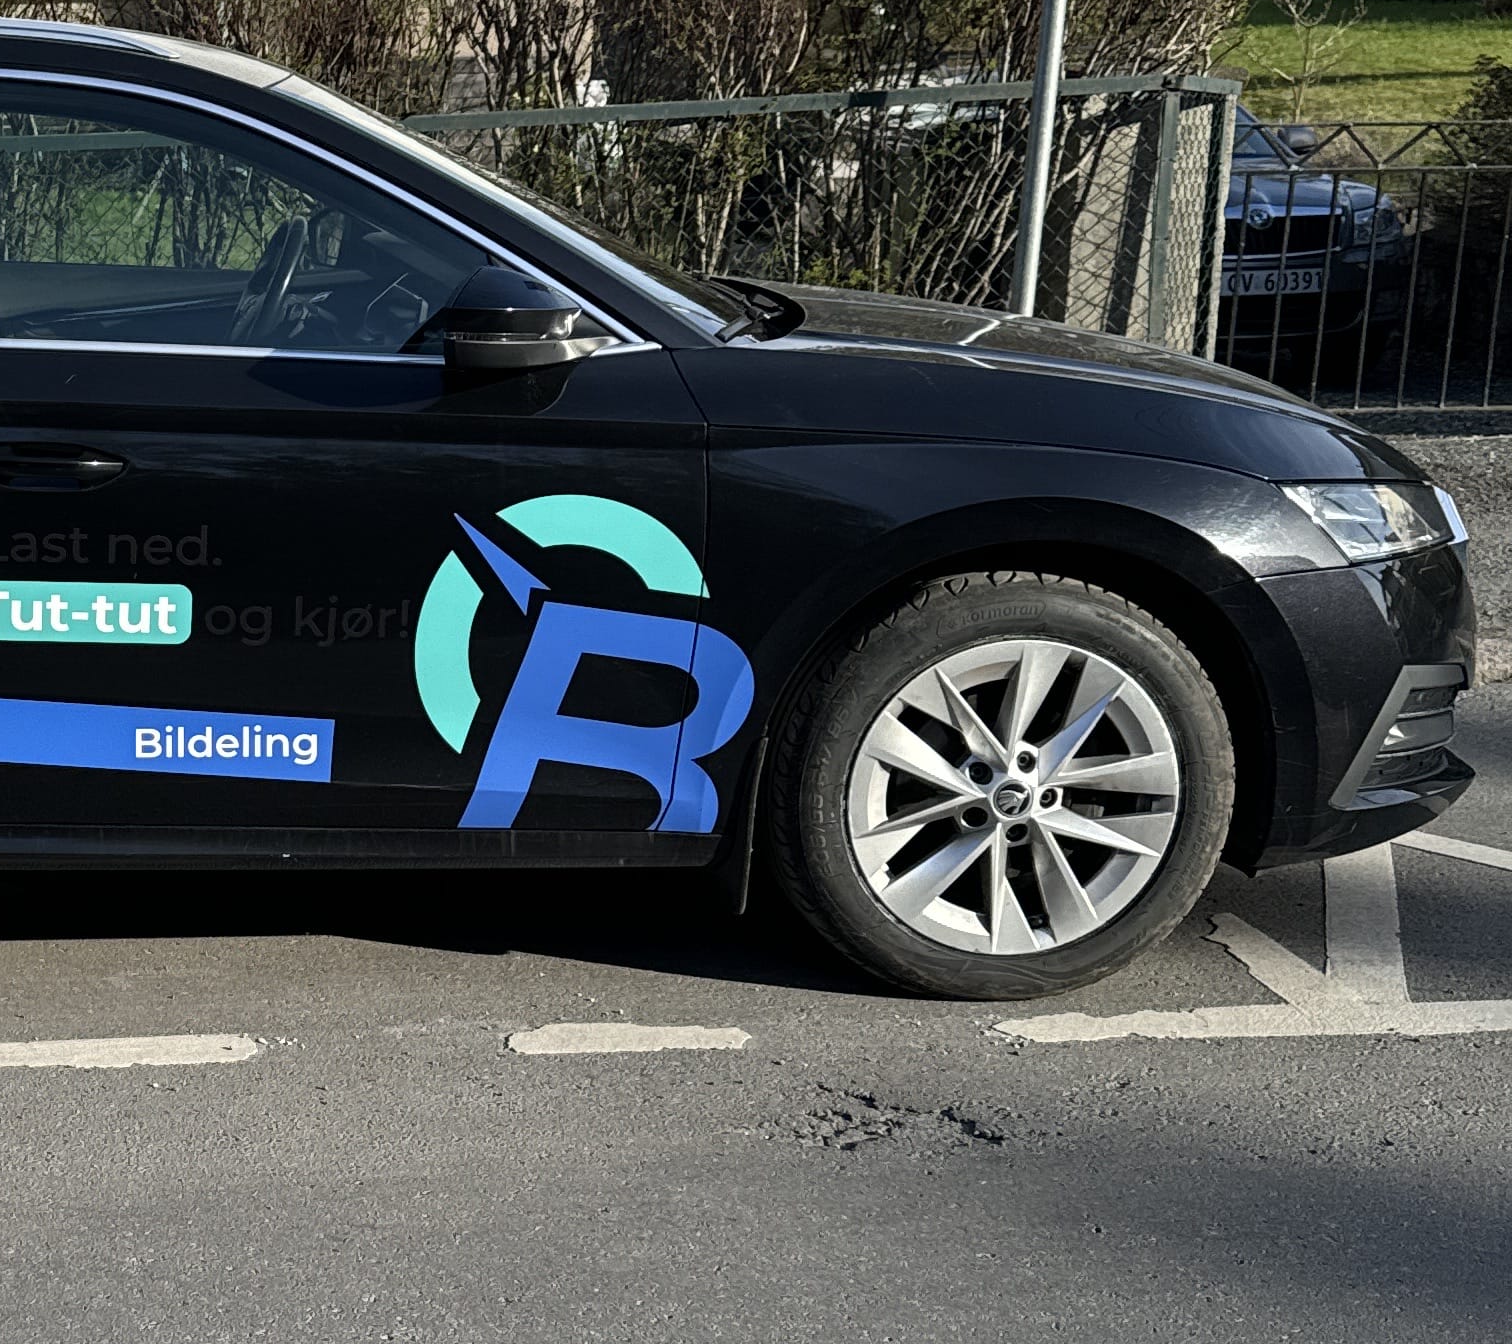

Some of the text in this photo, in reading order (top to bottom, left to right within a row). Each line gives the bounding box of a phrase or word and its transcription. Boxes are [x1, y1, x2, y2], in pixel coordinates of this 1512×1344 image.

[107, 524, 224, 567] ned.
[203, 603, 274, 647] og
[294, 593, 411, 648] kjør!
[133, 725, 319, 766] Bildeling
